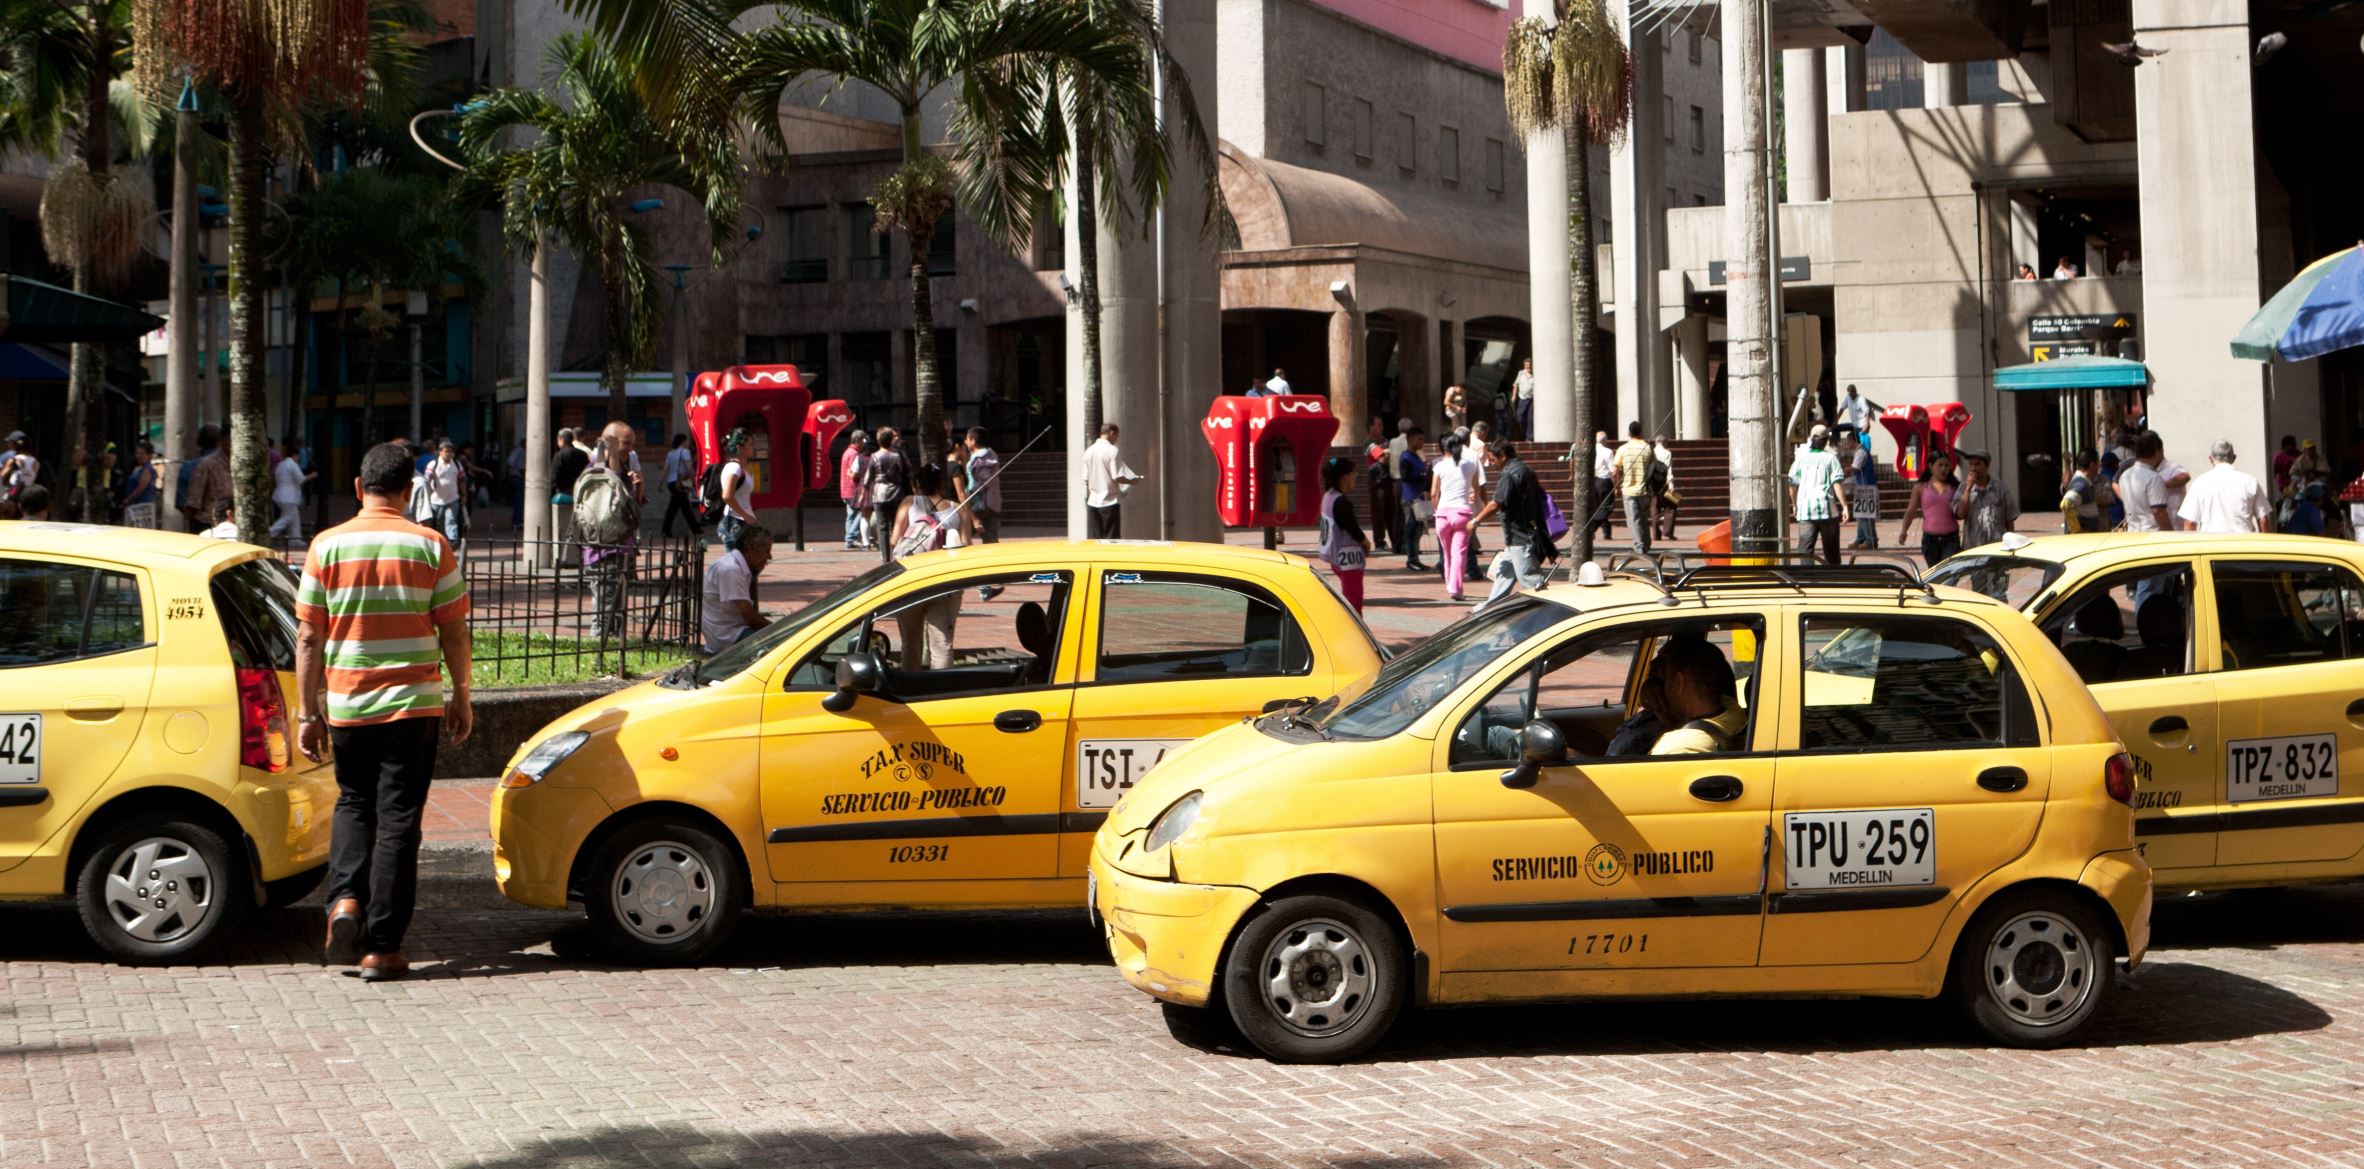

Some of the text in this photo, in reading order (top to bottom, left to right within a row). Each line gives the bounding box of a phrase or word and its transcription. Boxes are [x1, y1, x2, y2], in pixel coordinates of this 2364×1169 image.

[2064, 318, 2100, 326] Colombia
[2032, 326, 2059, 334] Parque
[739, 371, 791, 384] une
[1280, 401, 1322, 413] une
[817, 414, 848, 423] une
[1207, 416, 1232, 428] une
[1227, 441, 1235, 509] mejor juntos
[1855, 499, 1875, 514] 200
[1339, 551, 1363, 566] 200
[165, 606, 204, 620] 4954
[861, 741, 965, 780] TAX SUPER
[2232, 741, 2333, 784] TPZ 832
[1085, 748, 1134, 789] TSI
[2258, 783, 2306, 797] MEDELLIN
[821, 785, 1007, 815] SERVICIO PUBLICO
[1791, 818, 1929, 868] TPU 259
[888, 845, 950, 863] 10331
[1492, 850, 1714, 881] SERVICIO PUBLICO
[1829, 870, 1893, 885] MEDELLIN
[1567, 934, 1648, 955] 17701
